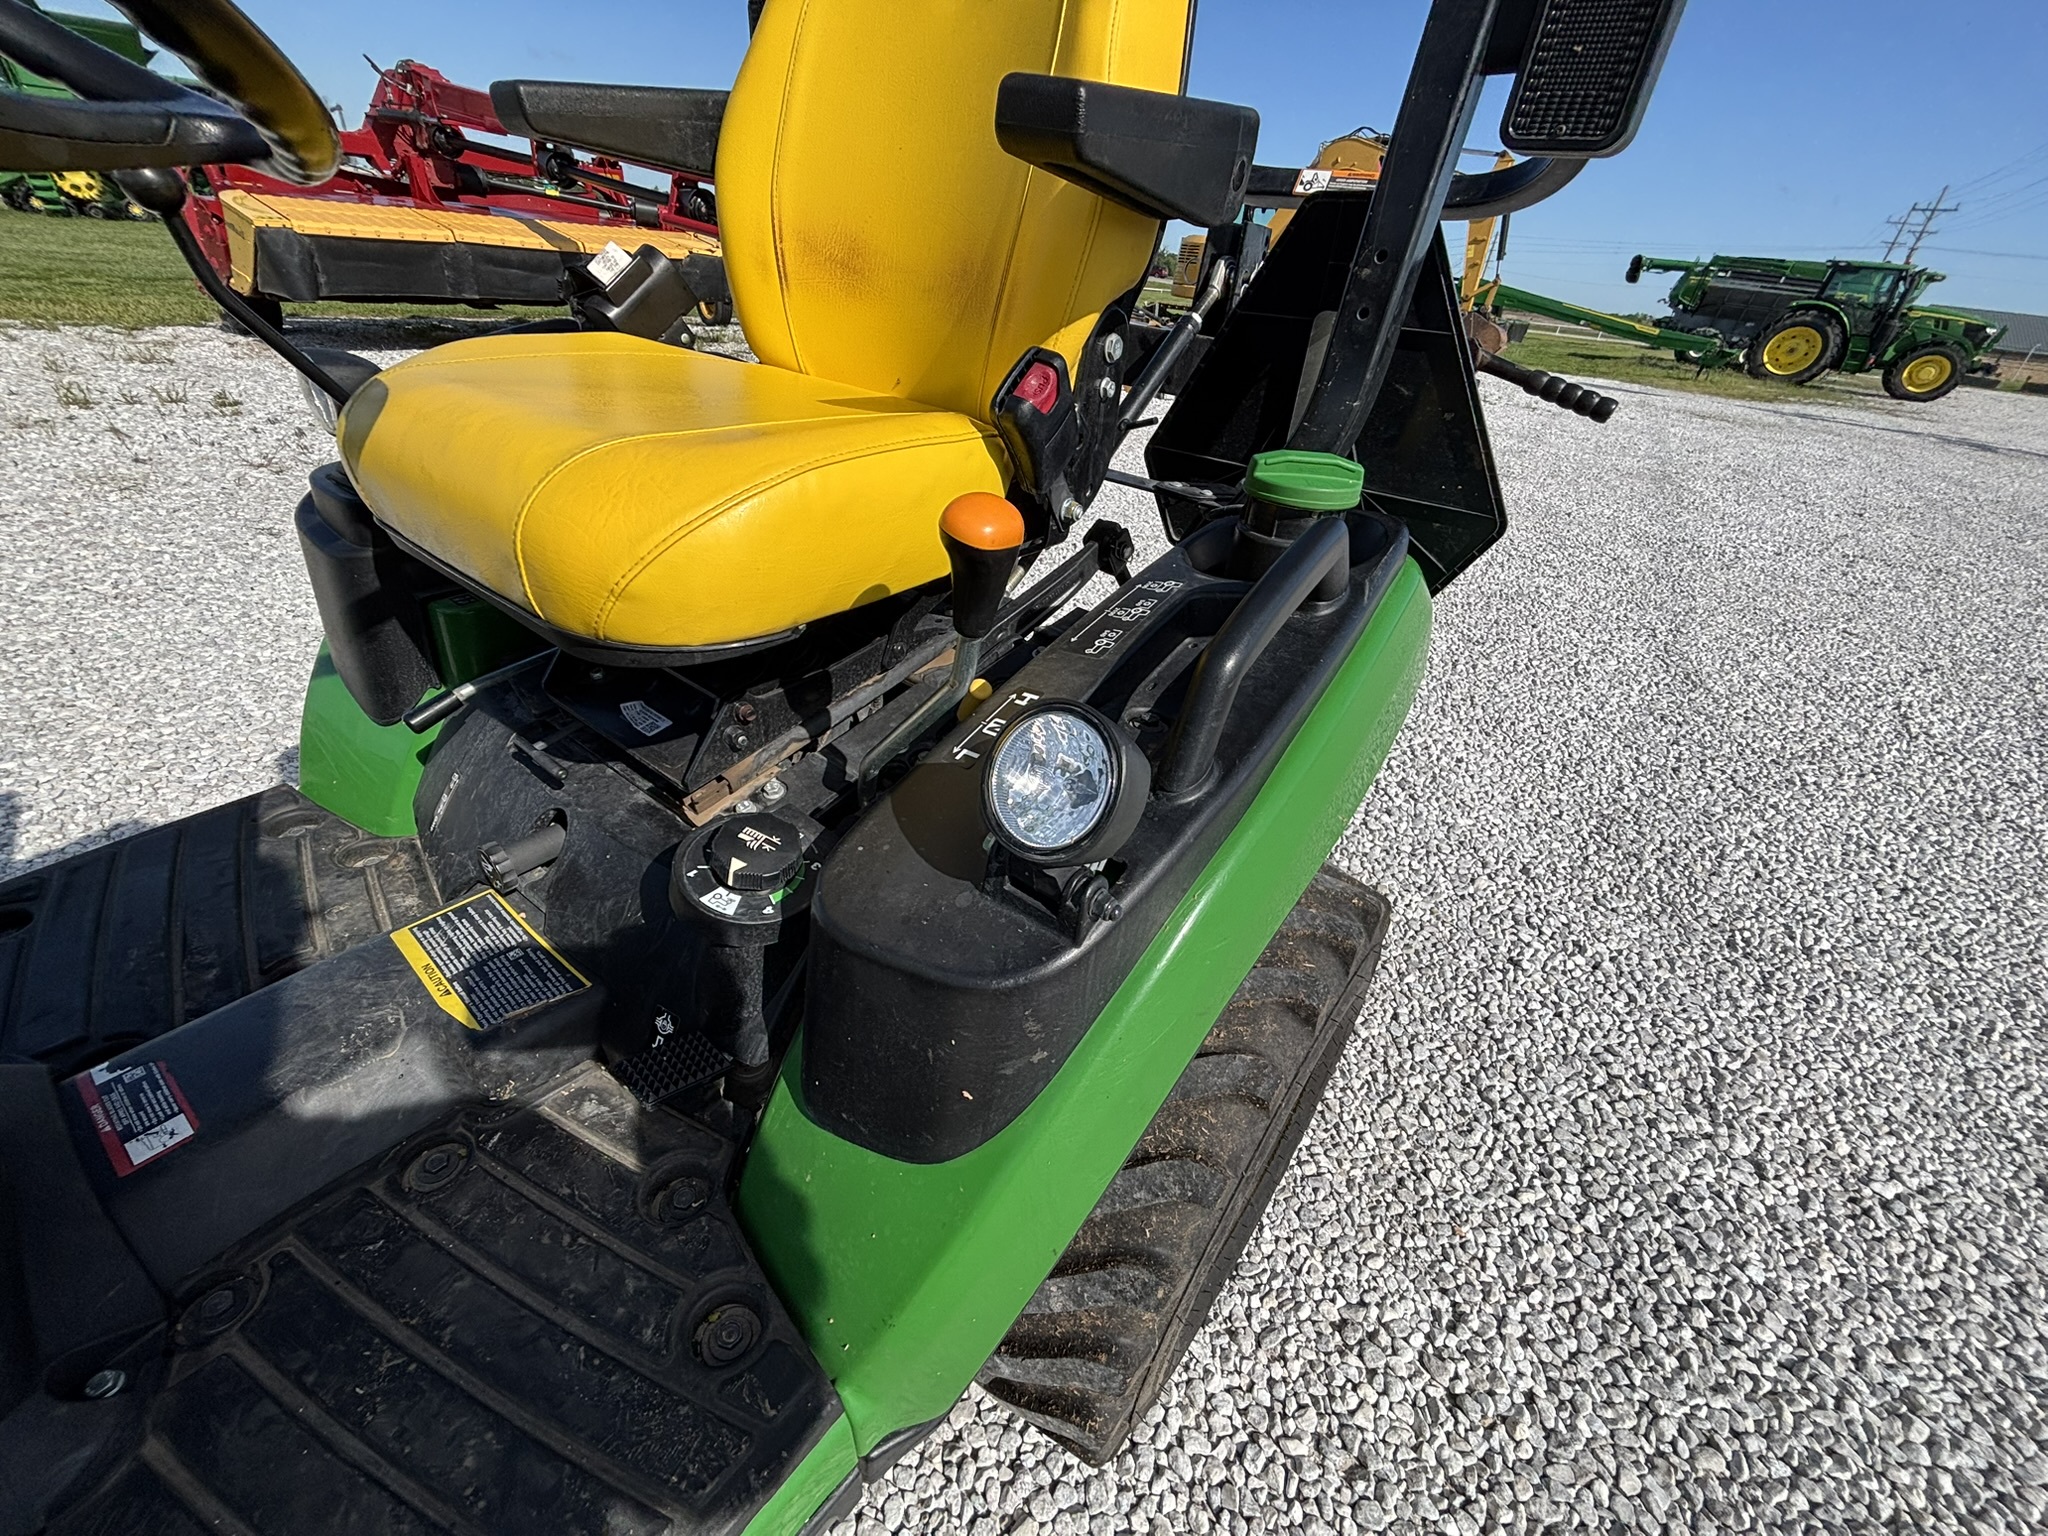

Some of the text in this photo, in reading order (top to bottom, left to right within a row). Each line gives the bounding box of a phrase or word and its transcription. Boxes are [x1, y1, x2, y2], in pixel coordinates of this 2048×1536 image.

[955, 749, 980, 760] L
[421, 962, 447, 992] CAUTION
[90, 1103, 109, 1128] DANGER
